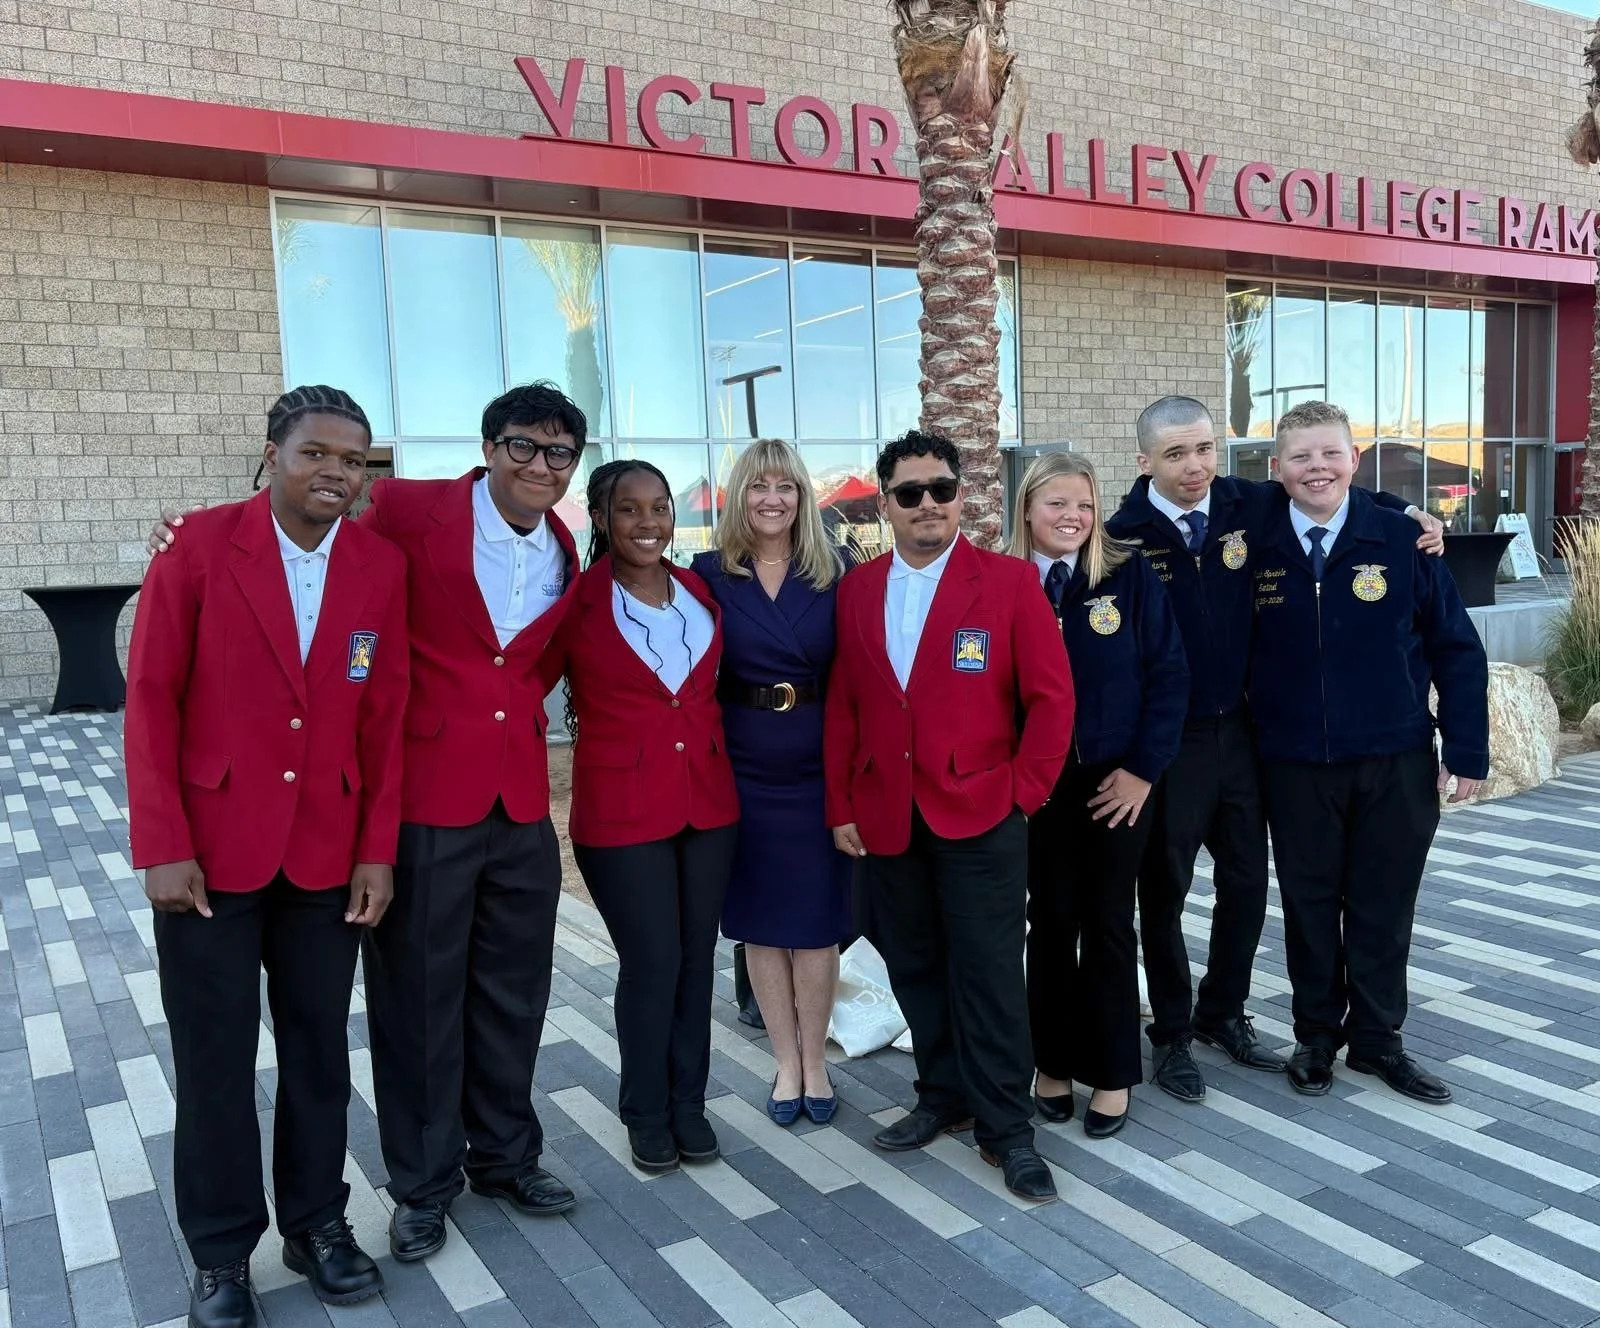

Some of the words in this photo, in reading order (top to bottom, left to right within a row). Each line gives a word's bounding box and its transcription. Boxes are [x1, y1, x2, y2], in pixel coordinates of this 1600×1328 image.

[514, 56, 899, 177] VICTOR
[990, 131, 1217, 212] ALLEY
[1234, 162, 1484, 245] COLLEGE
[1498, 196, 1600, 256] RAM
